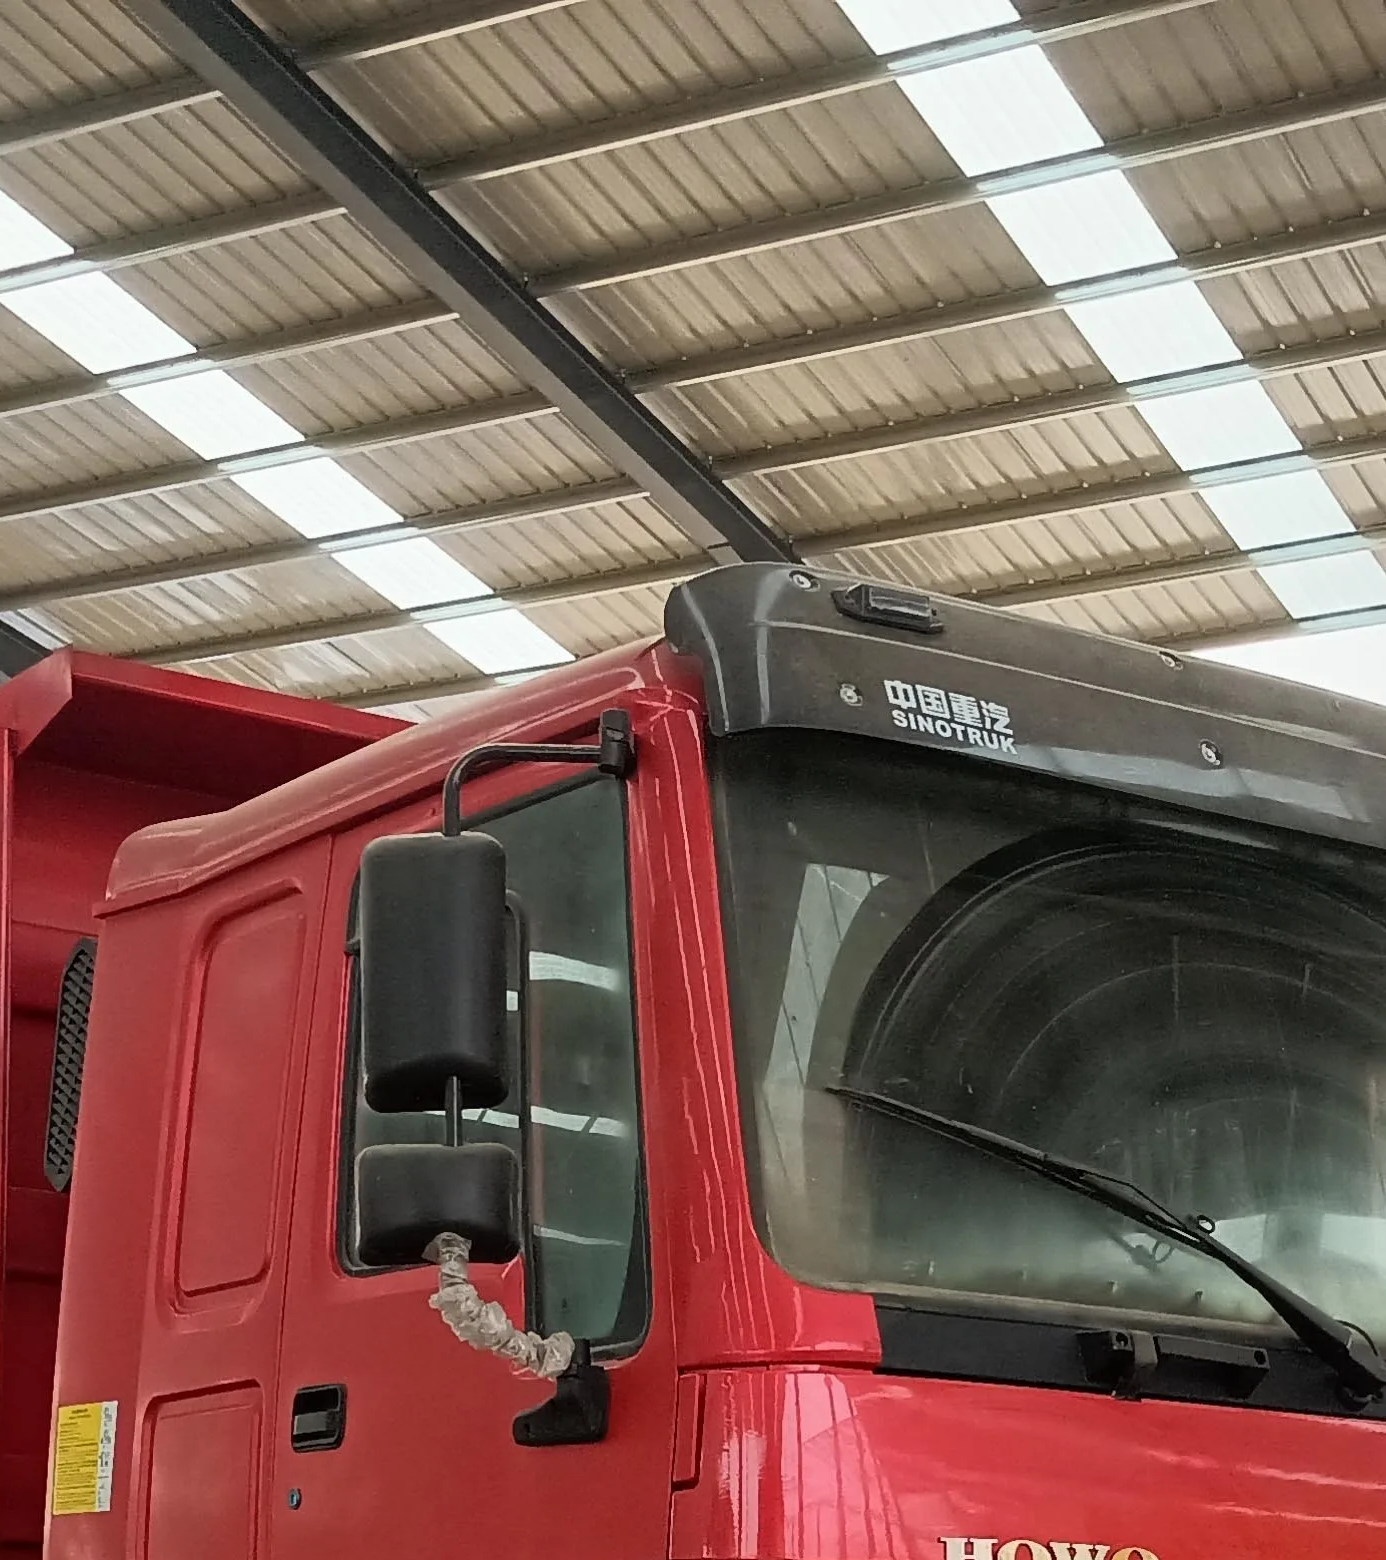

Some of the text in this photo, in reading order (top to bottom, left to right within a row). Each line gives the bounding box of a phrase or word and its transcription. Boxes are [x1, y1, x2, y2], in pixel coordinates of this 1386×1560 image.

[884, 680, 1013, 735] 中国重汽
[891, 709, 1018, 755] SINOTRUK
